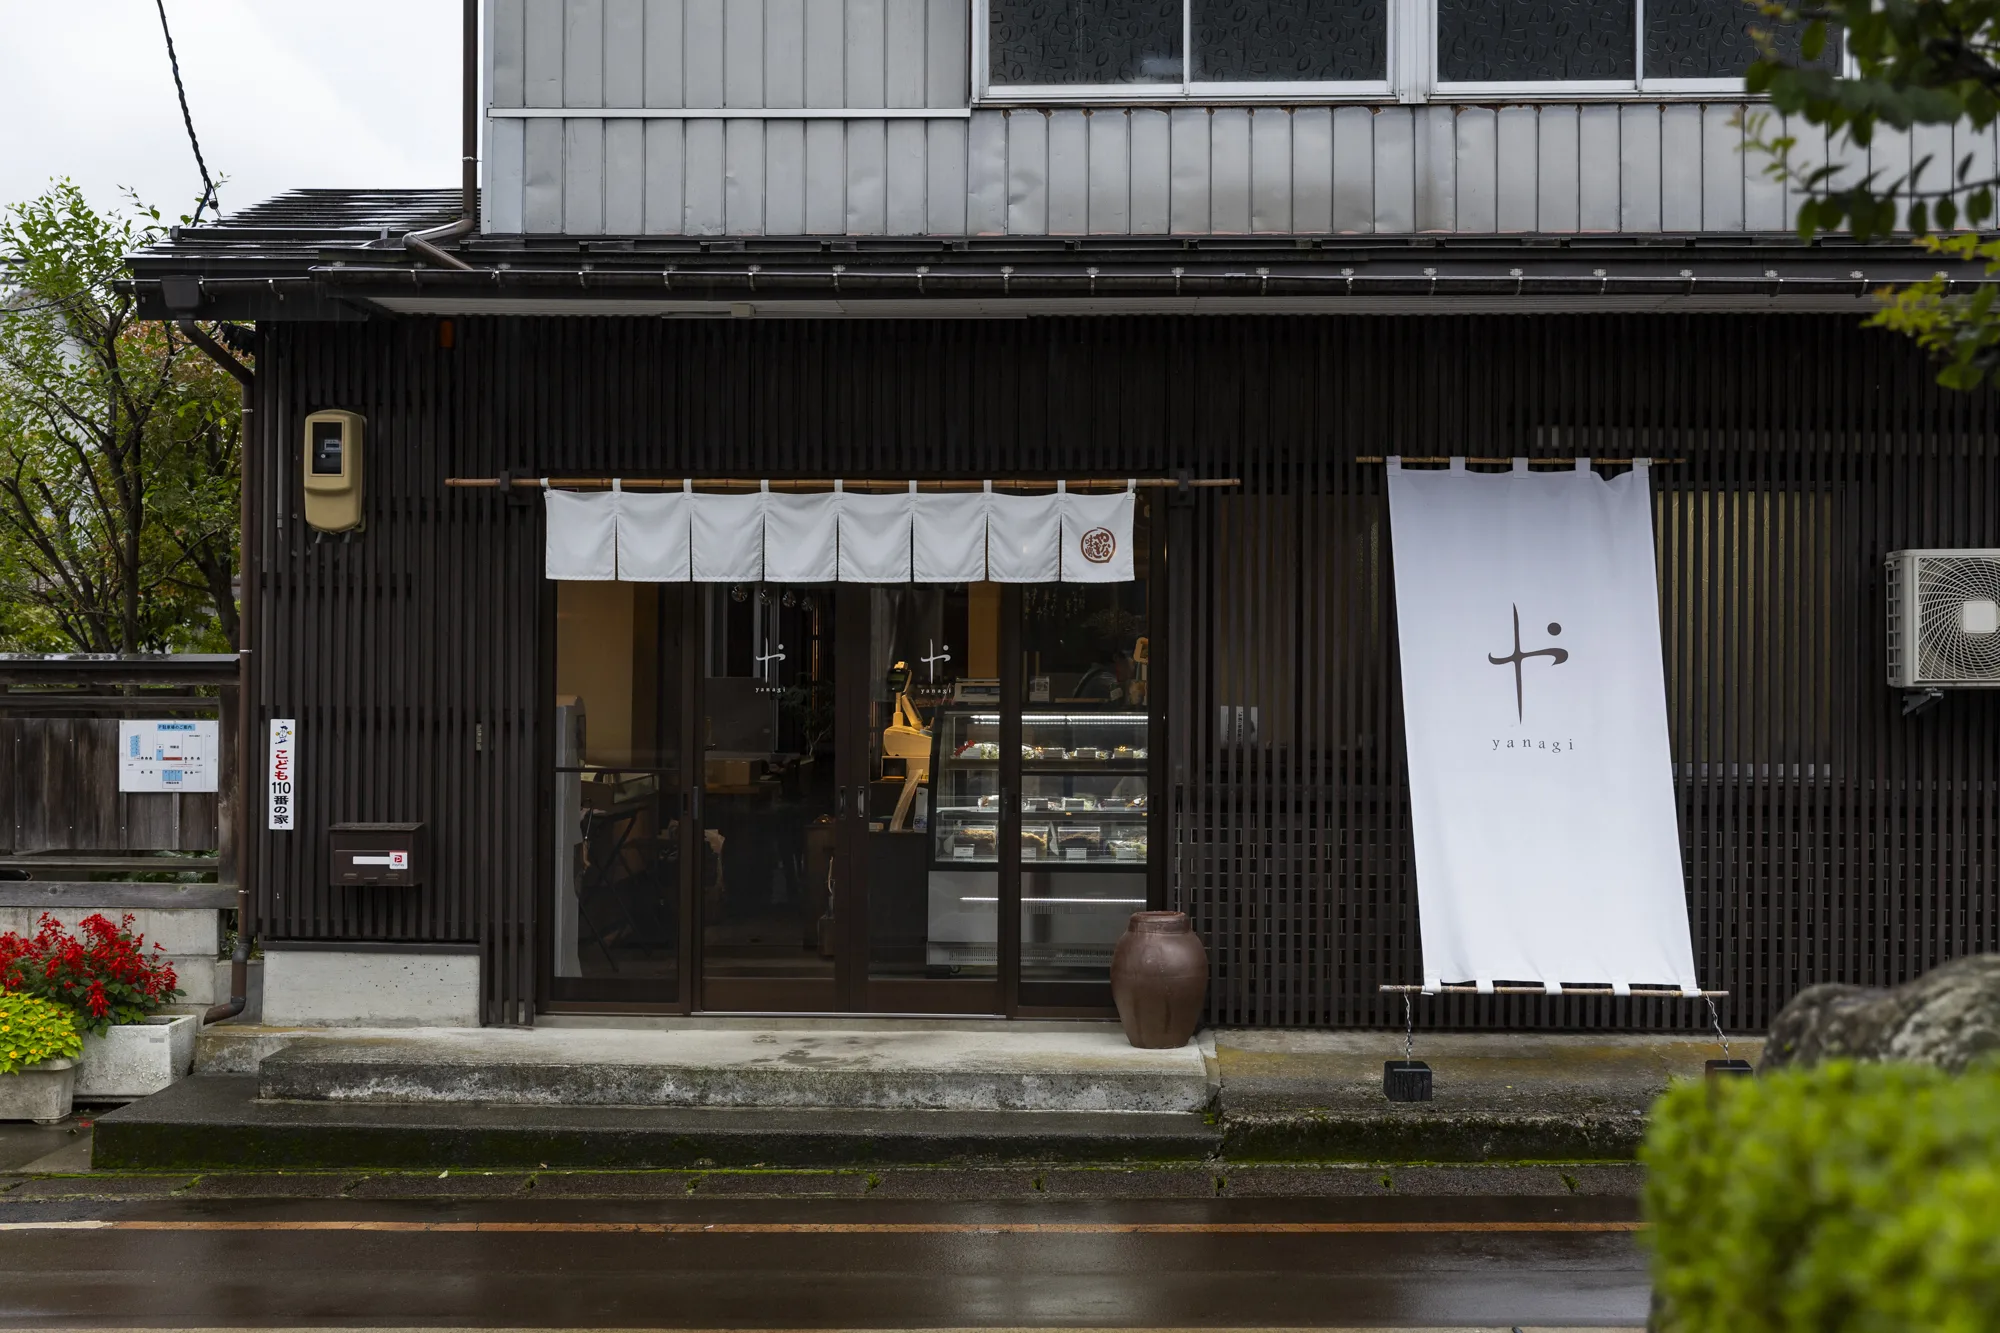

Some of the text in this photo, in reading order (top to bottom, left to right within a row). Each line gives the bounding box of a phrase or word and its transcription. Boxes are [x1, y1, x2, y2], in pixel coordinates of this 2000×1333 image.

[1492, 738, 1574, 754] yanagi
[271, 749, 292, 825] こども110番の家
